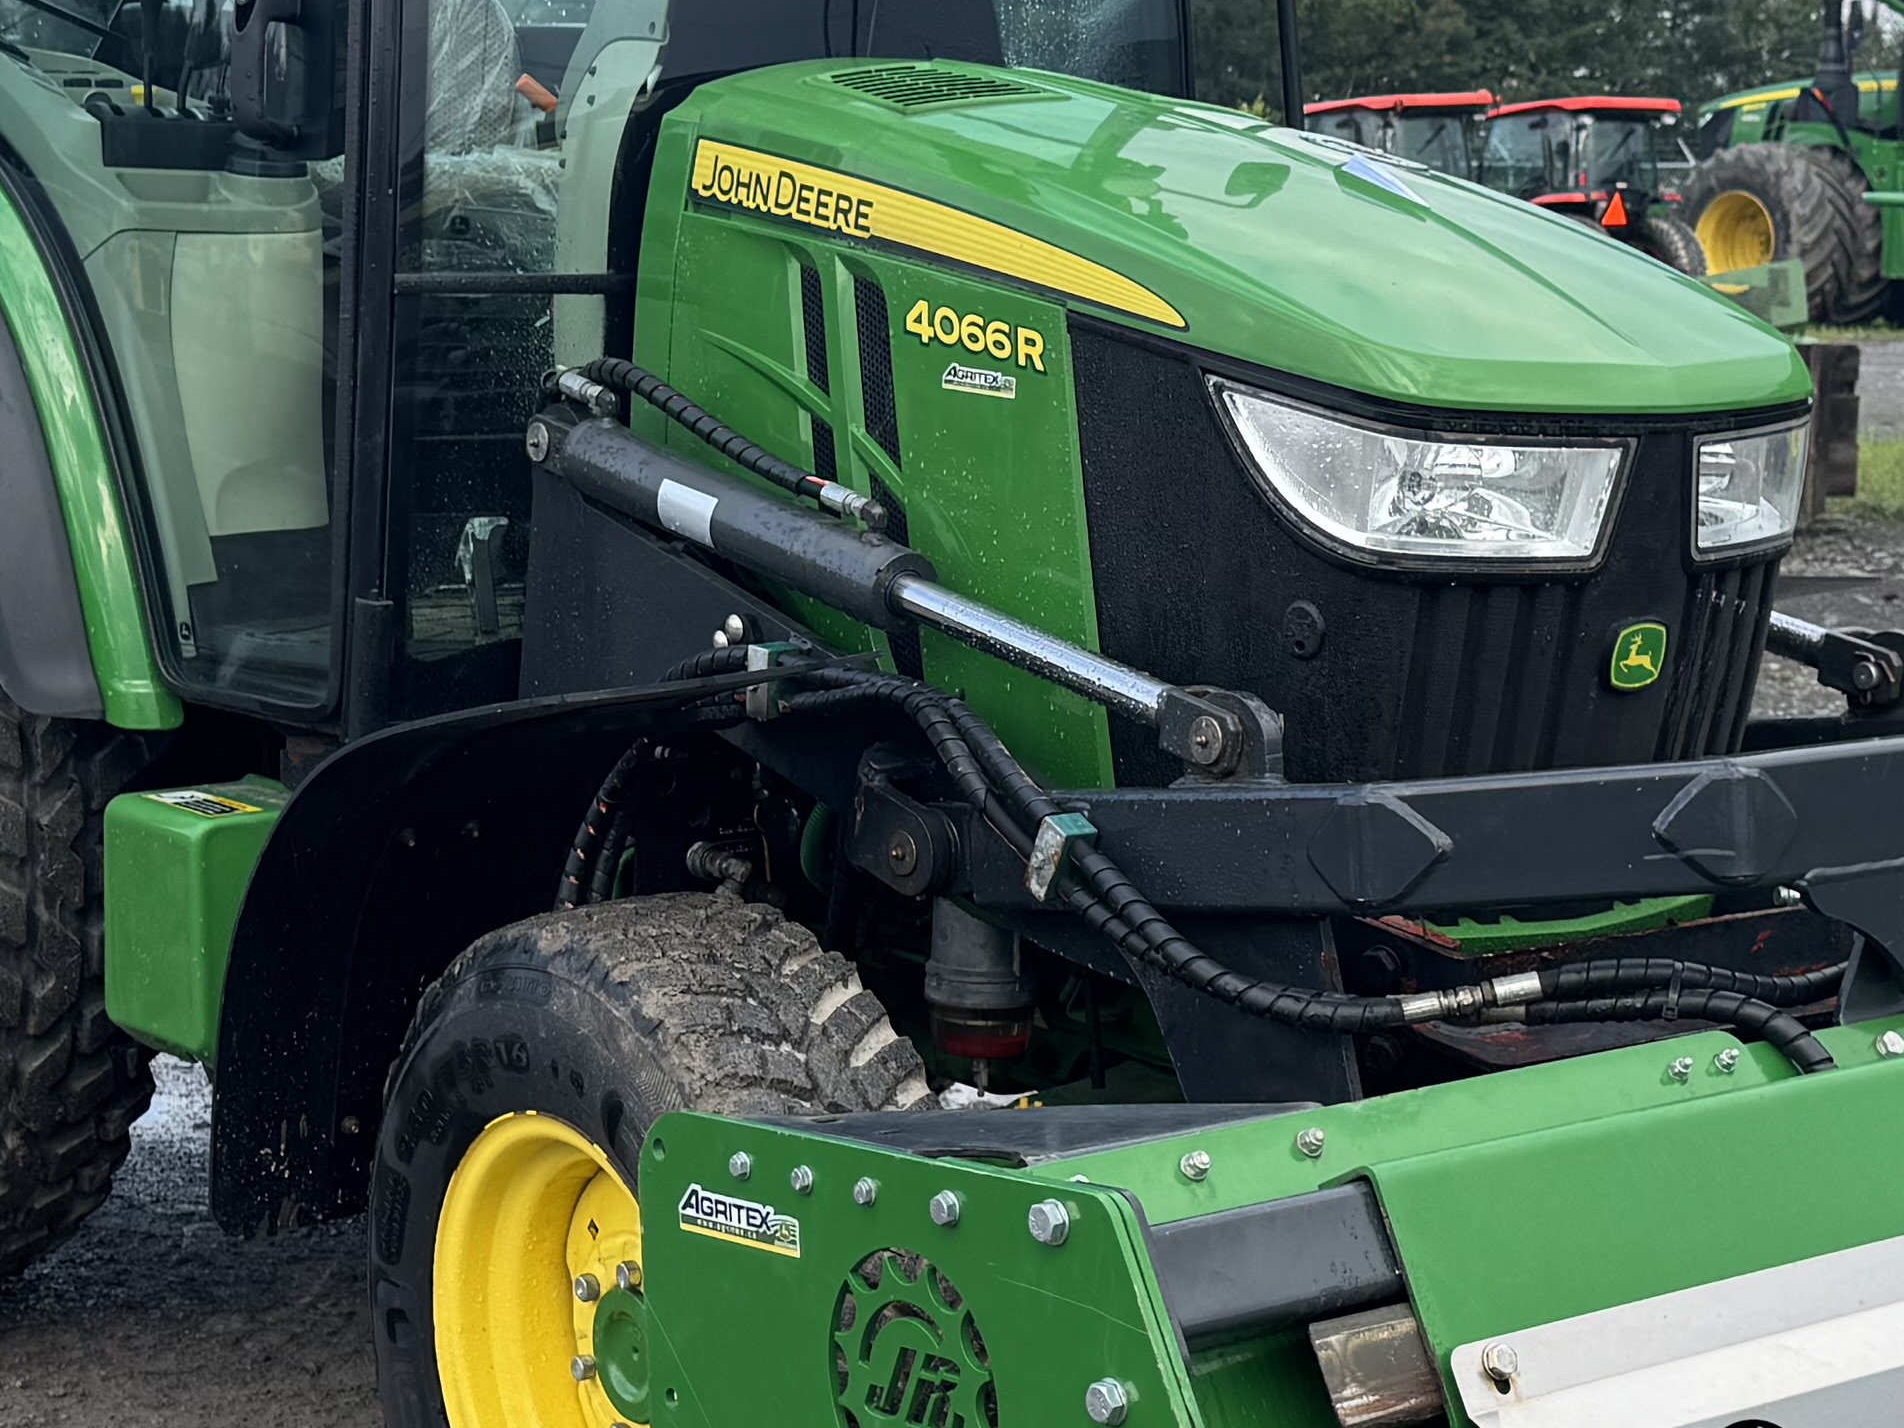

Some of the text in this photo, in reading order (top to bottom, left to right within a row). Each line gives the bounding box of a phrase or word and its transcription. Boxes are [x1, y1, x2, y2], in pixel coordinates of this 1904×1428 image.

[702, 154, 875, 234] JOHN DEERE
[945, 365, 1000, 385] AGRITEX
[681, 1188, 771, 1232] AGRITEX
